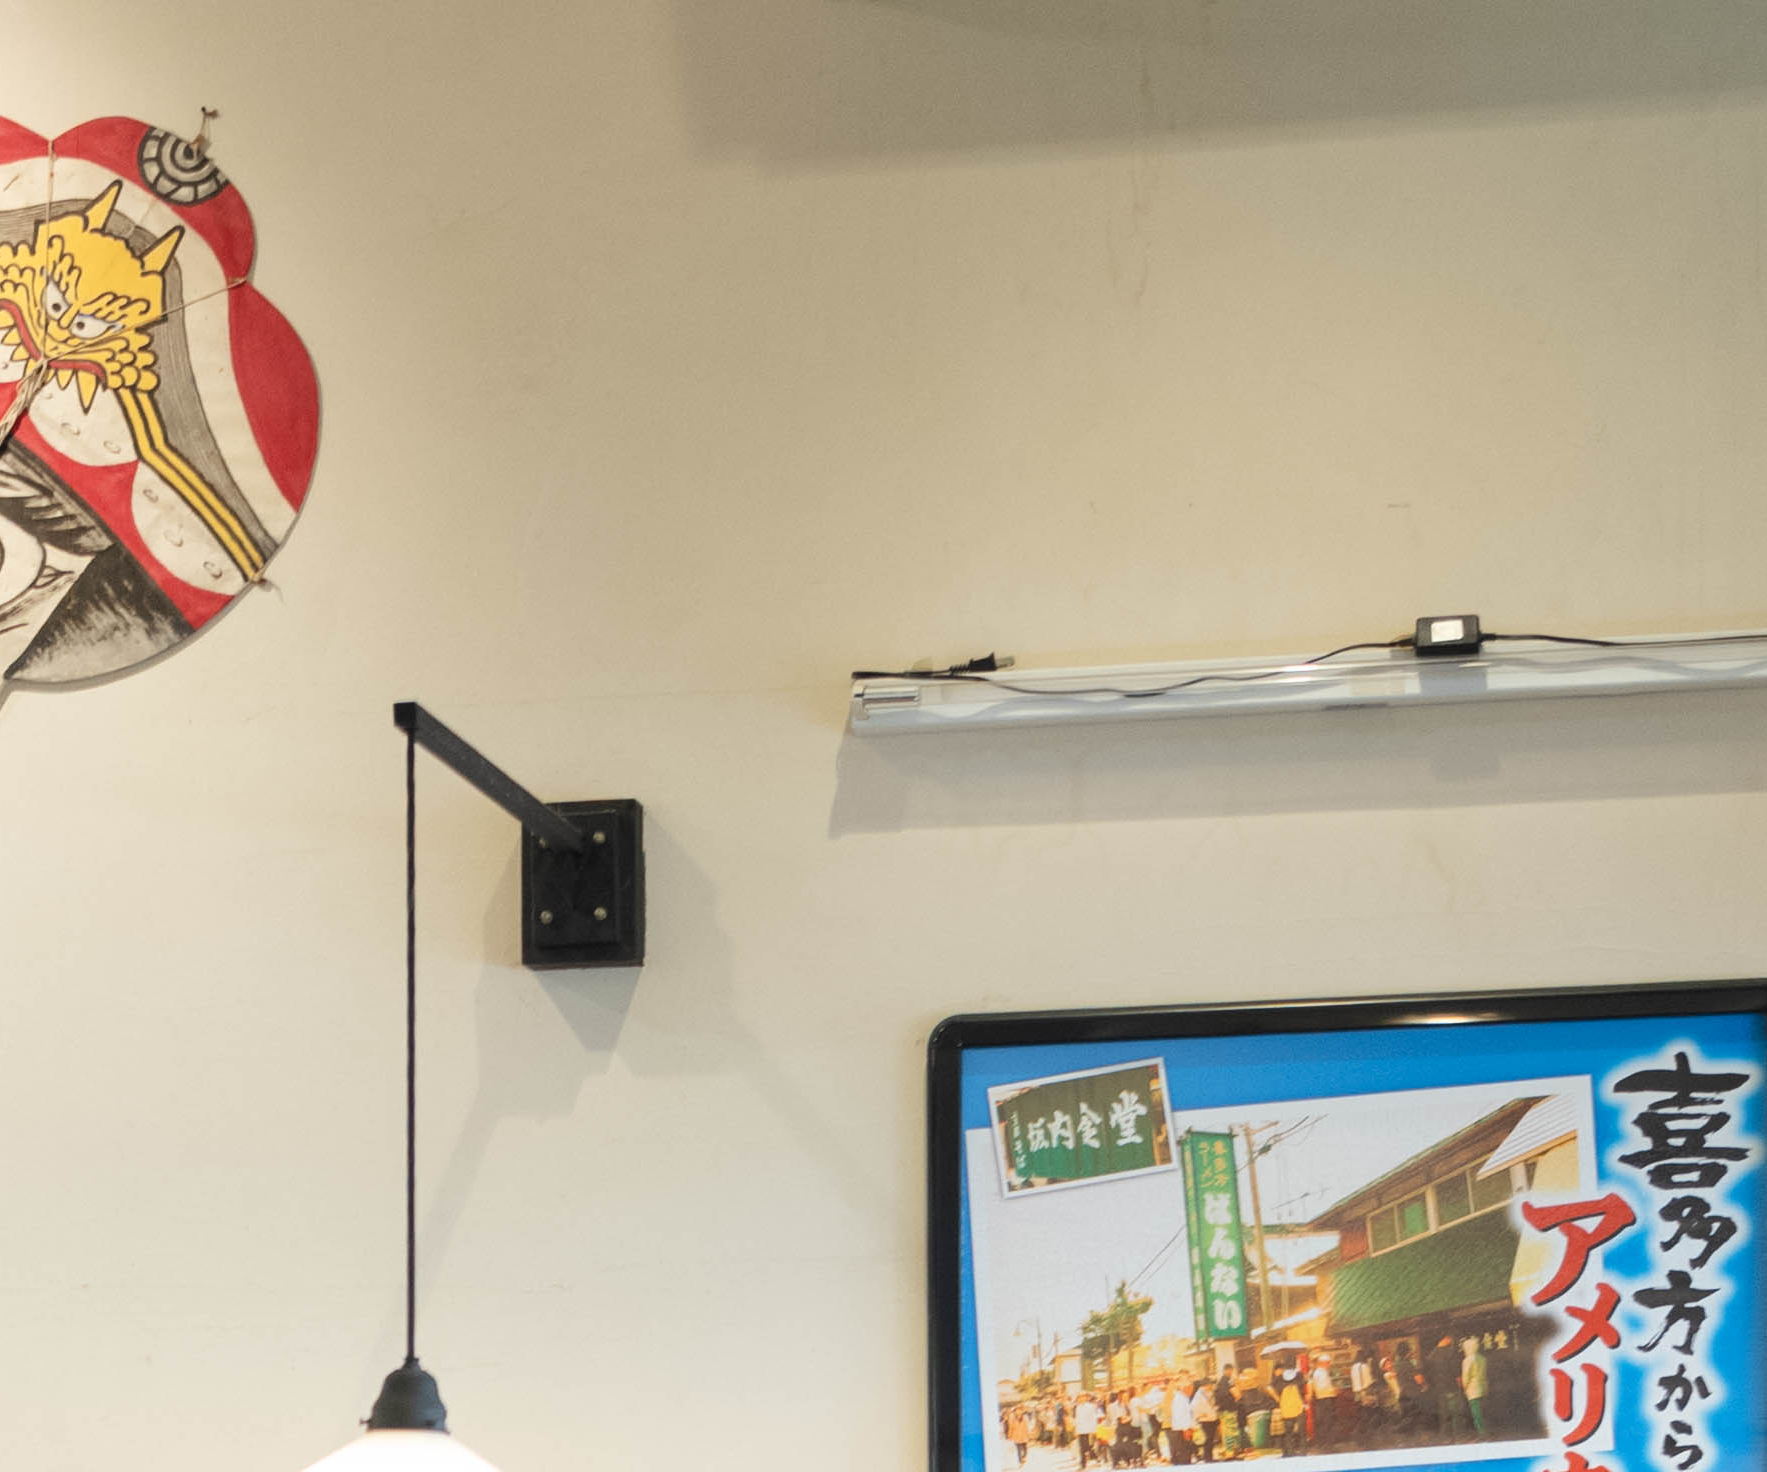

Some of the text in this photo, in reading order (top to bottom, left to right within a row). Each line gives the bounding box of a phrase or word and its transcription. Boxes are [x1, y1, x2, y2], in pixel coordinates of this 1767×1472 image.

[1204, 1192, 1243, 1331] ばんない
[1613, 1051, 1750, 1472] 喜多方から
